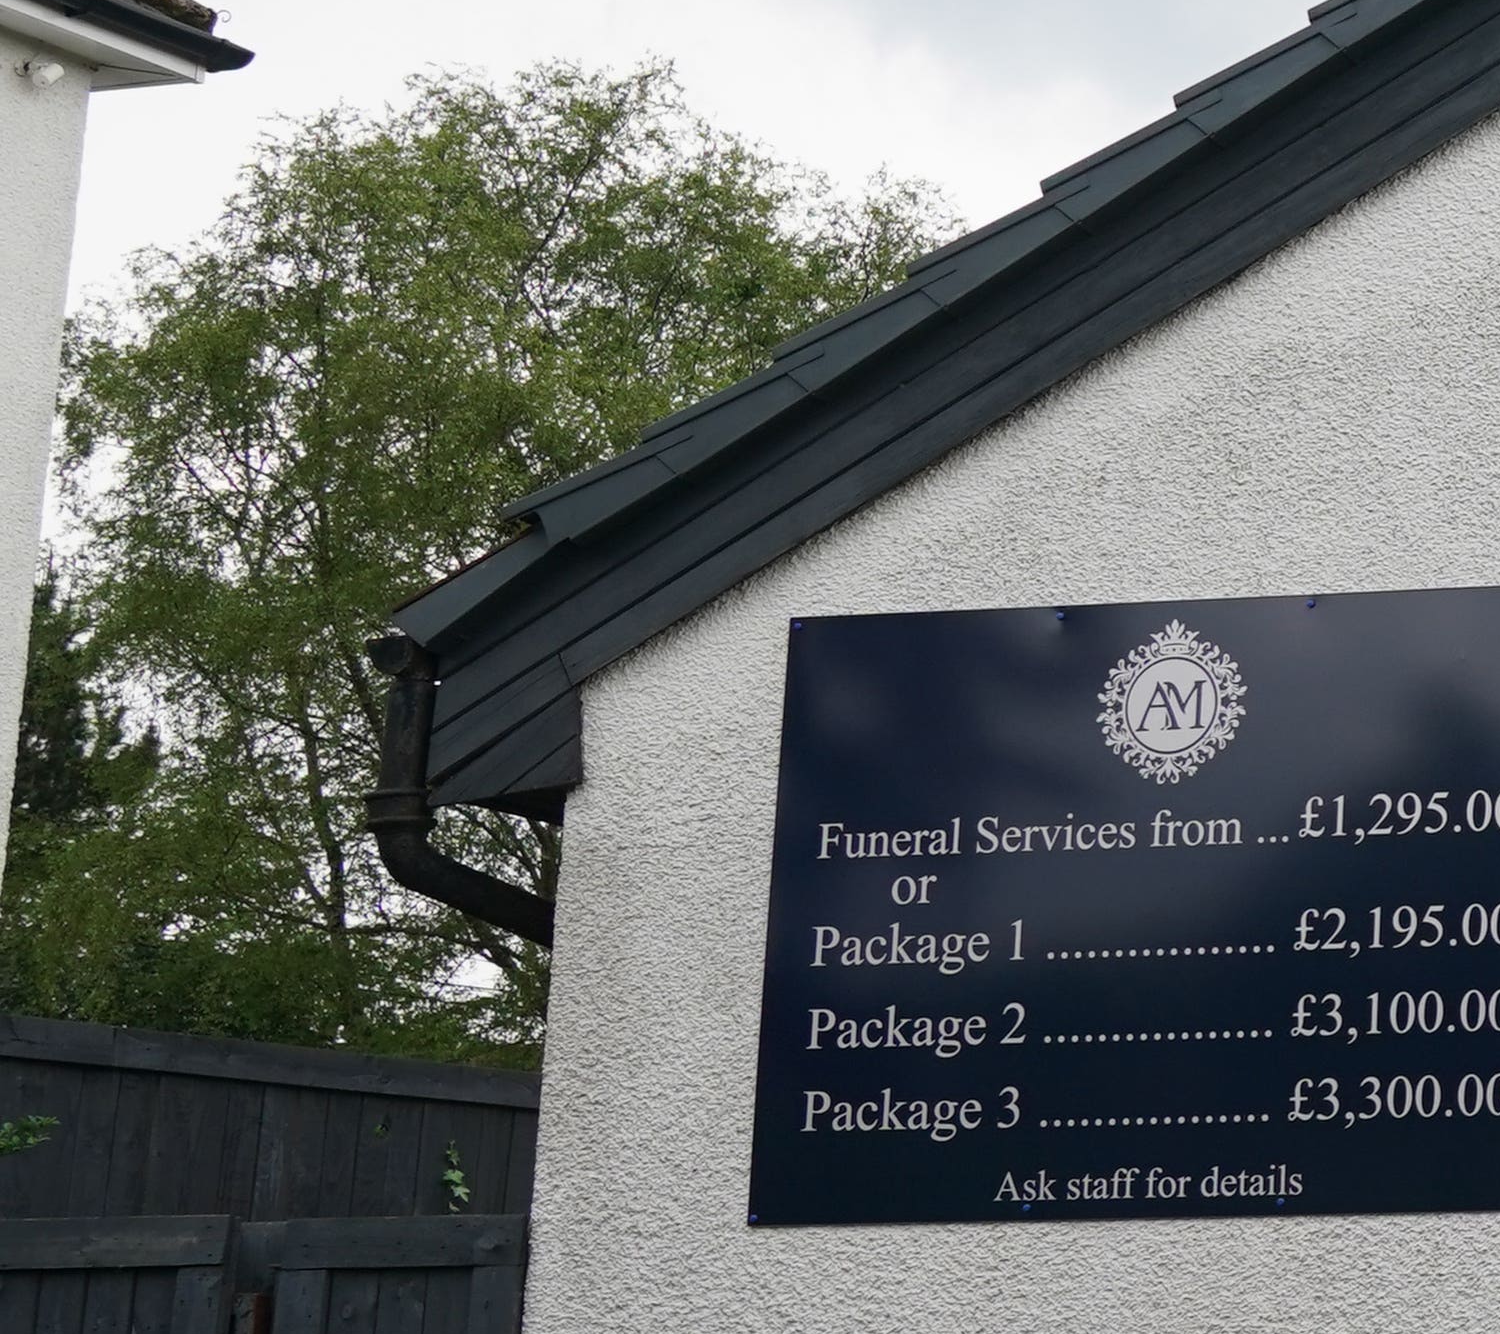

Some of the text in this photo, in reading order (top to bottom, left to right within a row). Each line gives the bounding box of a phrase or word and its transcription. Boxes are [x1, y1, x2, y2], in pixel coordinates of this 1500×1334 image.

[817, 817, 960, 859] Funeral
[976, 813, 1135, 853] Services
[1151, 810, 1242, 847] from
[892, 876, 937, 904] or
[811, 923, 989, 974] Package
[1010, 920, 1024, 960] 1
[807, 1005, 986, 1057] Package
[1000, 1003, 1025, 1043] 2
[801, 1088, 981, 1141] Package
[998, 1087, 1019, 1128] 3
[994, 1165, 1302, 1201] Ask staff for details
